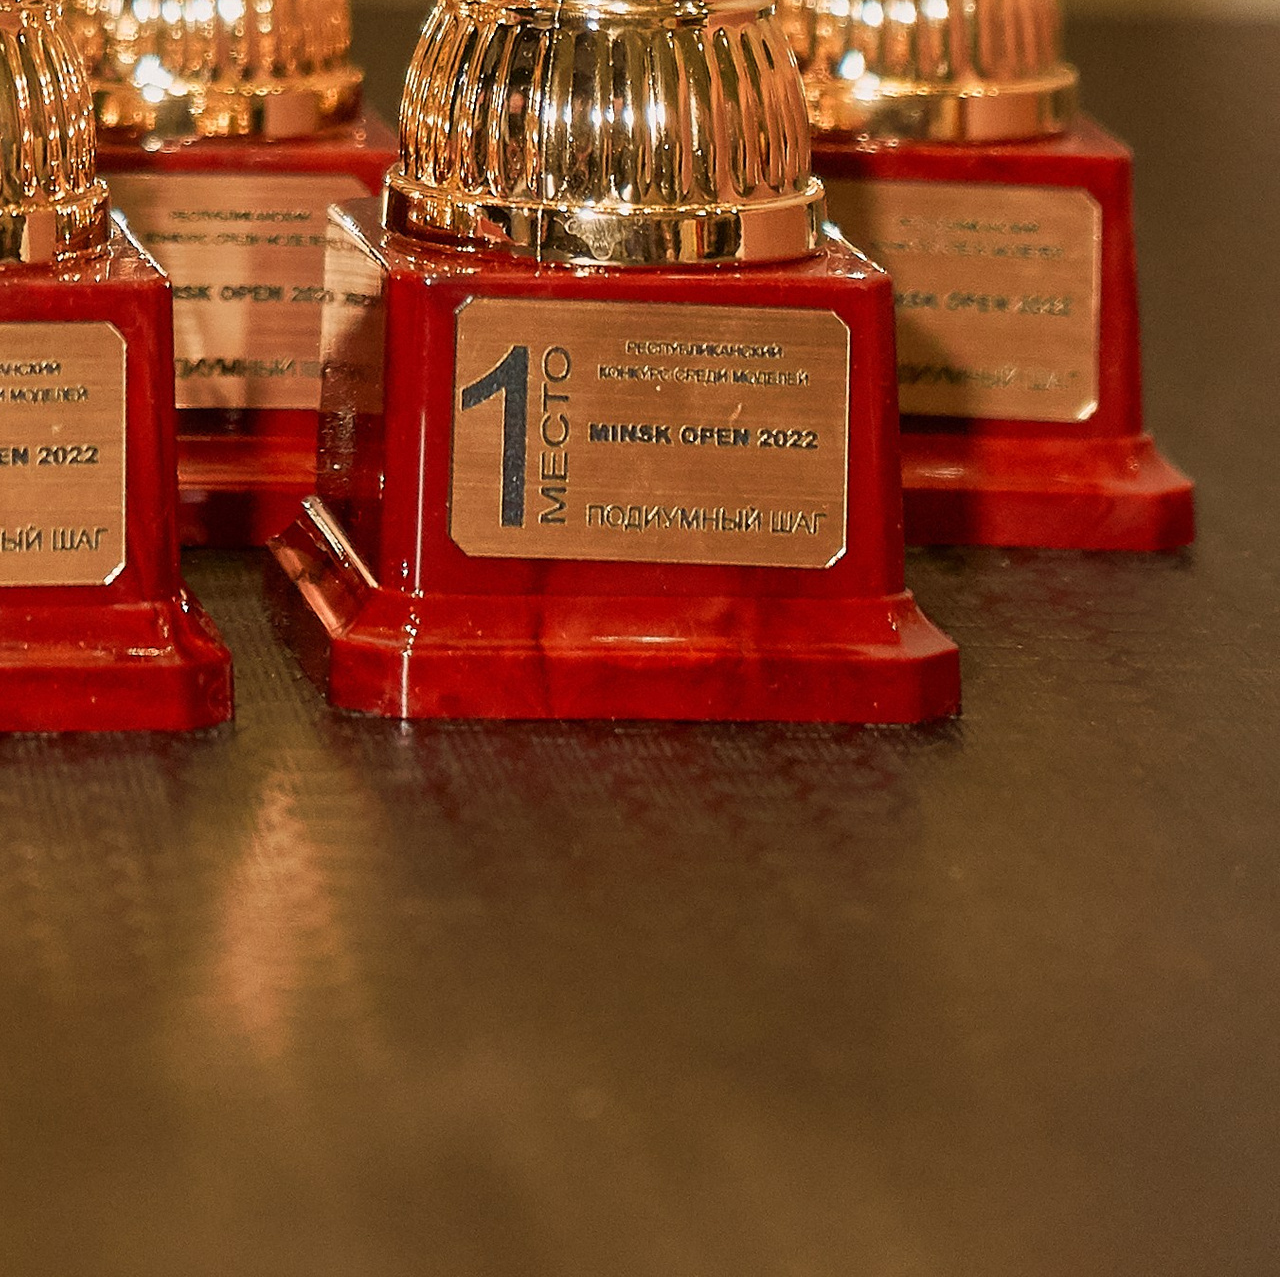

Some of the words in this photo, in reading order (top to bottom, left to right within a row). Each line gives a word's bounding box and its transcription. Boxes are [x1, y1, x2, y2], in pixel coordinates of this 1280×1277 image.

[626, 342, 783, 359] РЕСПУБЛИКАНСКИЙ
[599, 366, 670, 381] КОНКУРС
[674, 367, 728, 383] СРЕДИ
[731, 369, 809, 387] МОДЕЛЕЙ
[10, 387, 89, 403] МОДЕЛЕЙ
[461, 346, 529, 528] 1
[540, 346, 572, 524] МЕСТО
[589, 424, 670, 444] MINSK
[681, 427, 750, 446] OPEN
[758, 429, 819, 449] 2022
[37, 446, 99, 465] 2022
[587, 505, 763, 534] ПОДИУМНЫЙ
[770, 513, 827, 534] ШАГ
[51, 529, 108, 552] ШАГ
